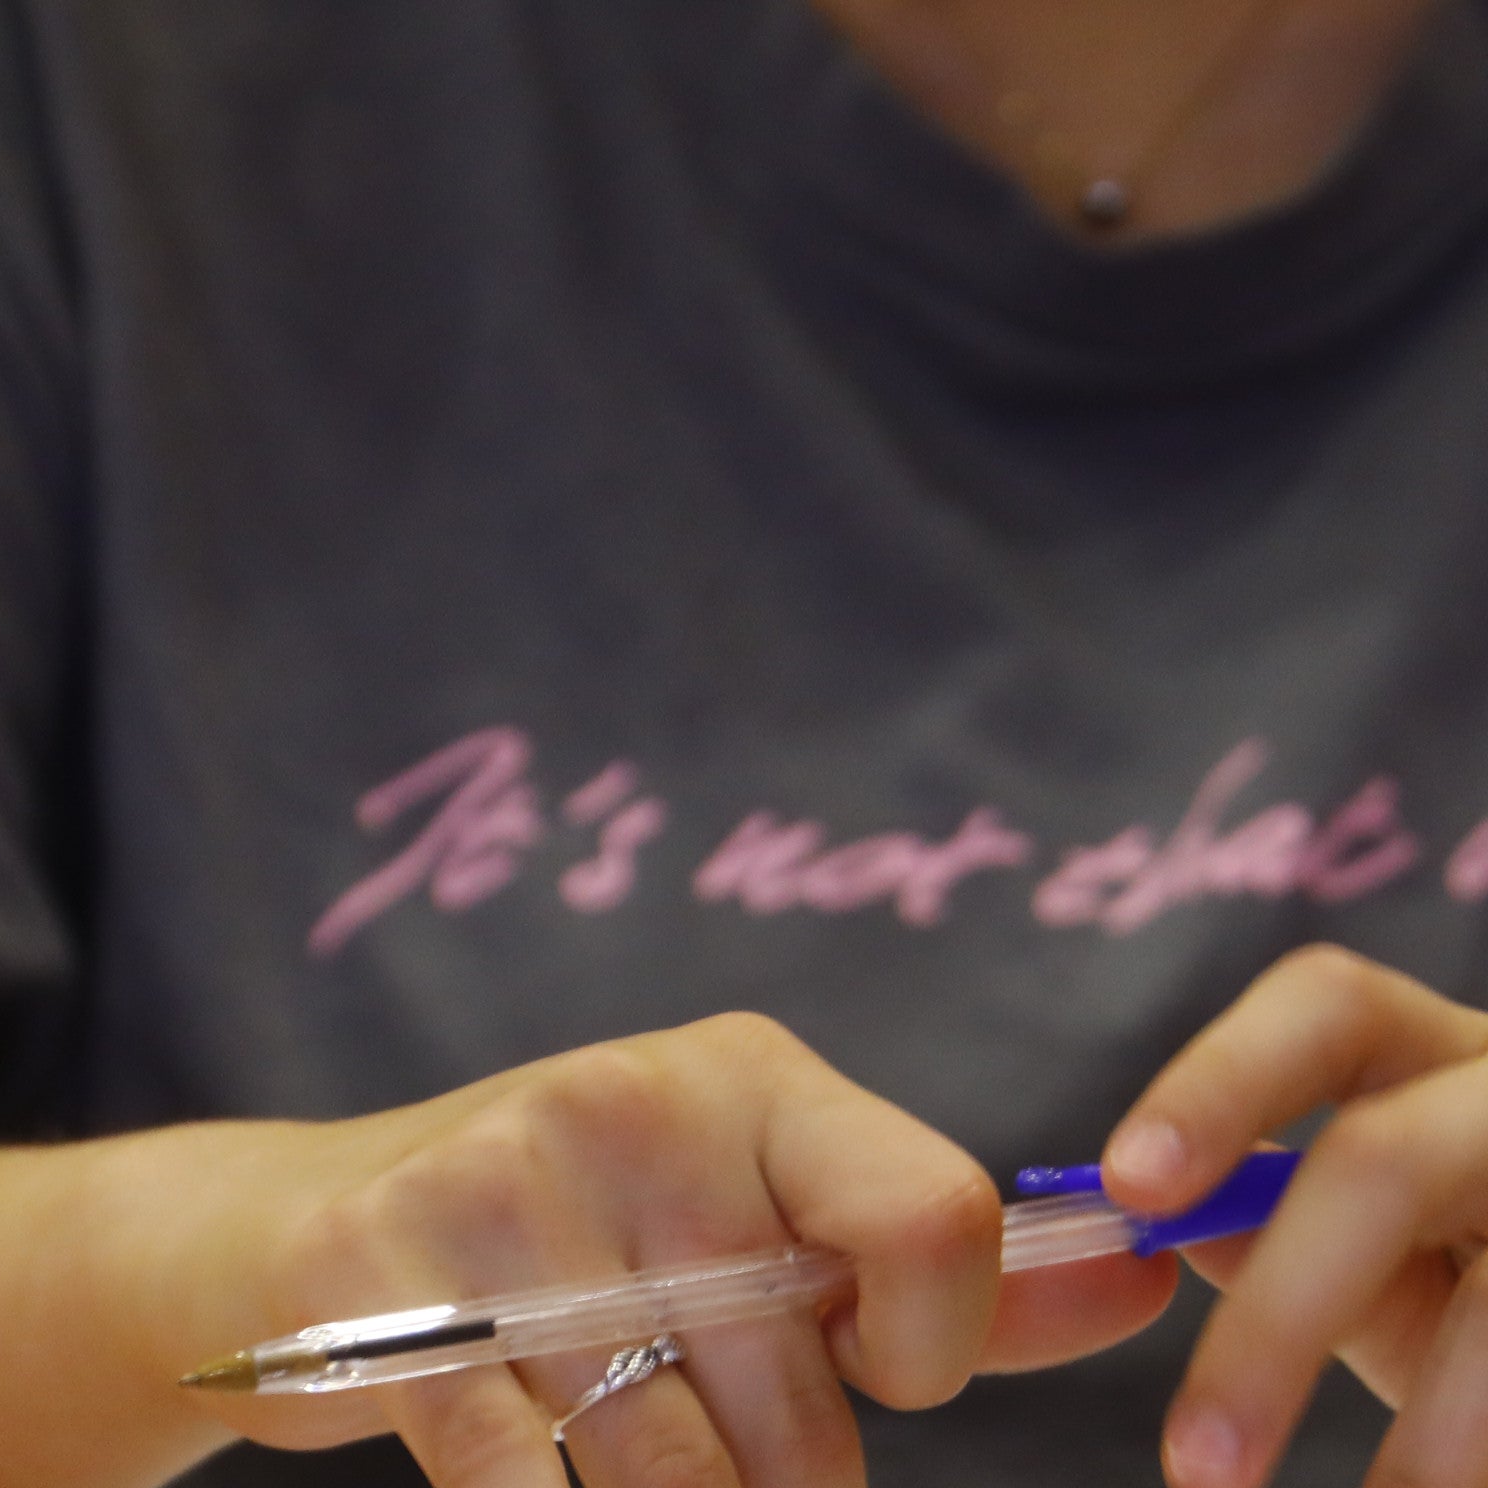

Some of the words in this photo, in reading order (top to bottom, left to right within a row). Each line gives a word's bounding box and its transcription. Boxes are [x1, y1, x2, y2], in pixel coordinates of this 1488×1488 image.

[309, 725, 667, 960] It's
[692, 805, 1032, 926] not
[1034, 735, 1418, 936] that
